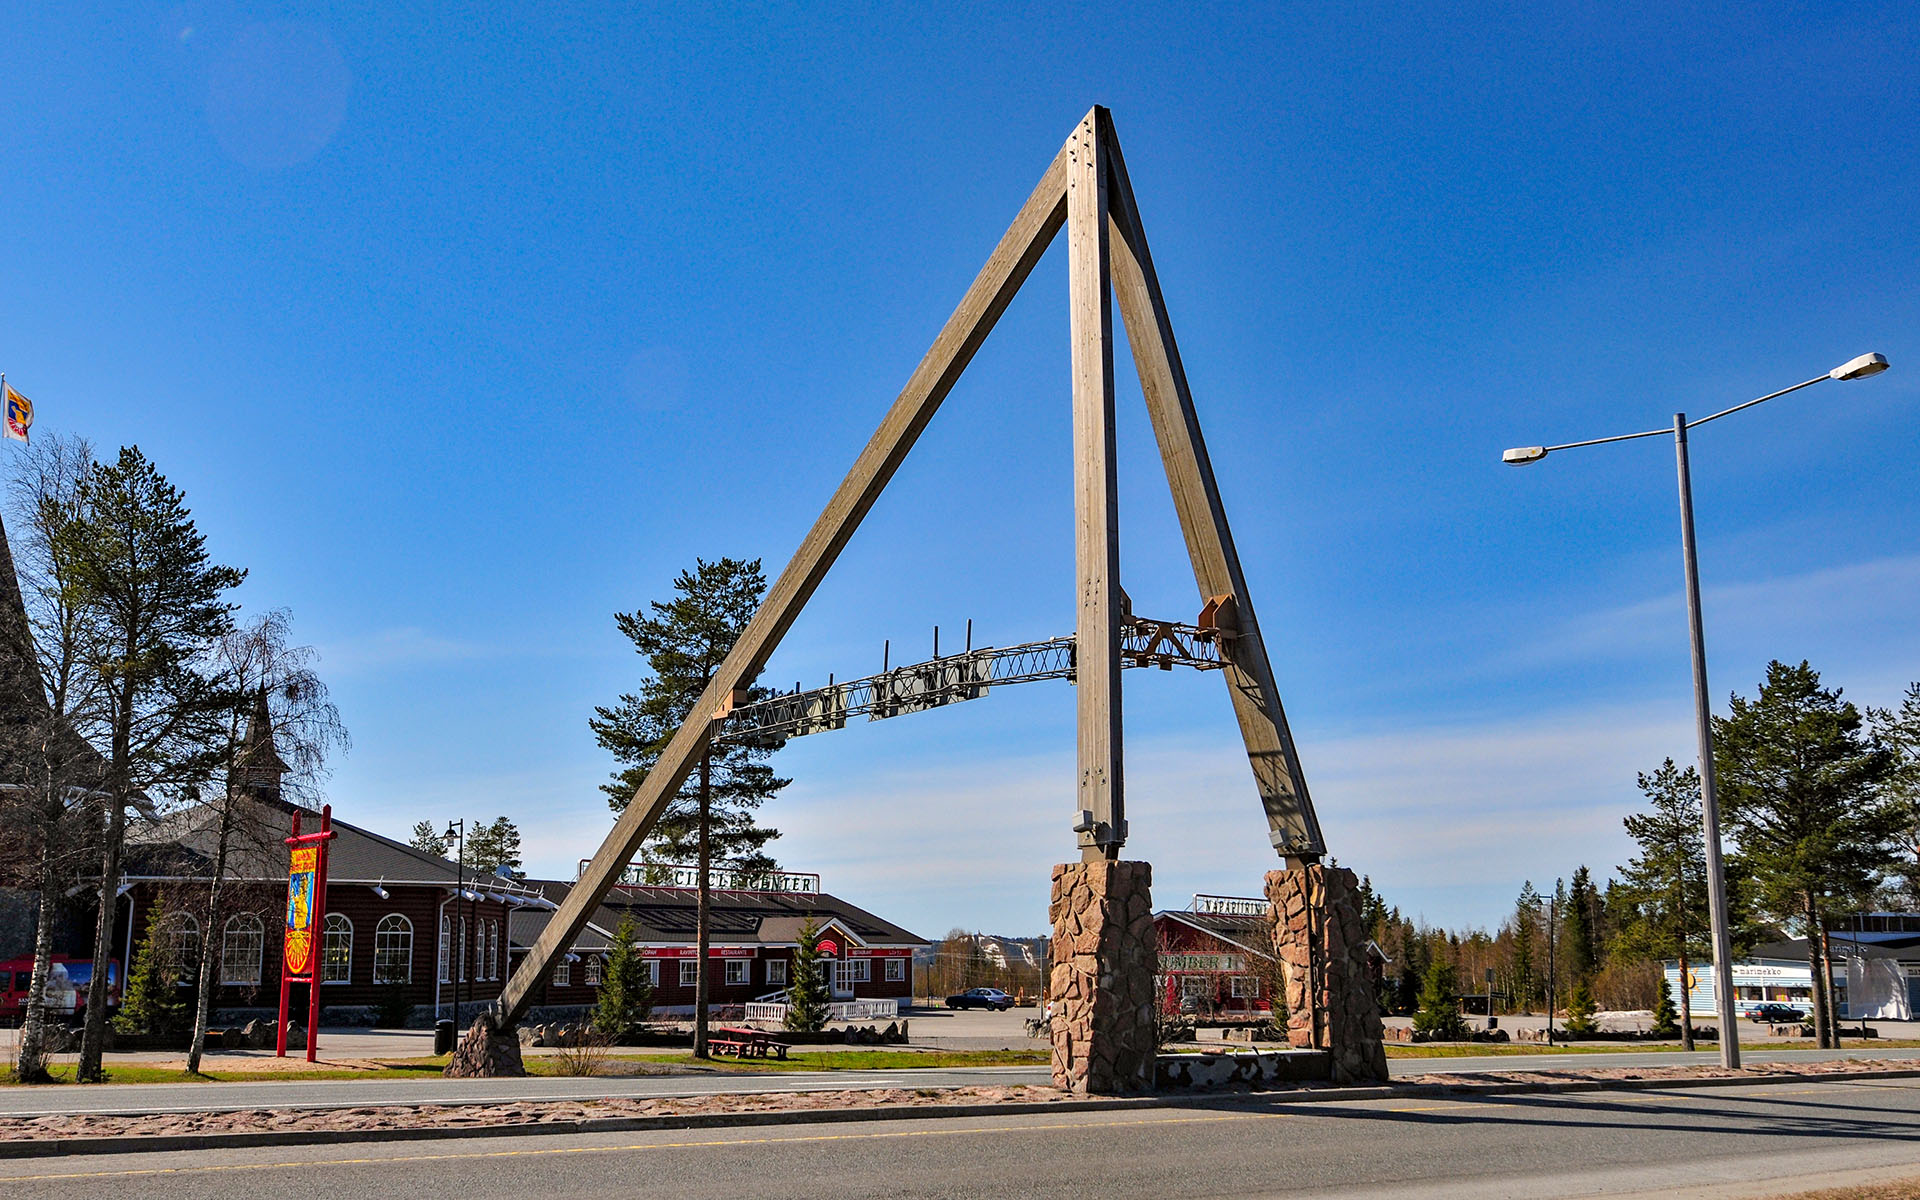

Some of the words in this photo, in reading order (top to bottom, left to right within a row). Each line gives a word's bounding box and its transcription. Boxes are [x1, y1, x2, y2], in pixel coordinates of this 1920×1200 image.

[675, 869, 740, 888] CICLE
[748, 872, 811, 893] CENTER
[1739, 967, 1782, 976] marimekko
